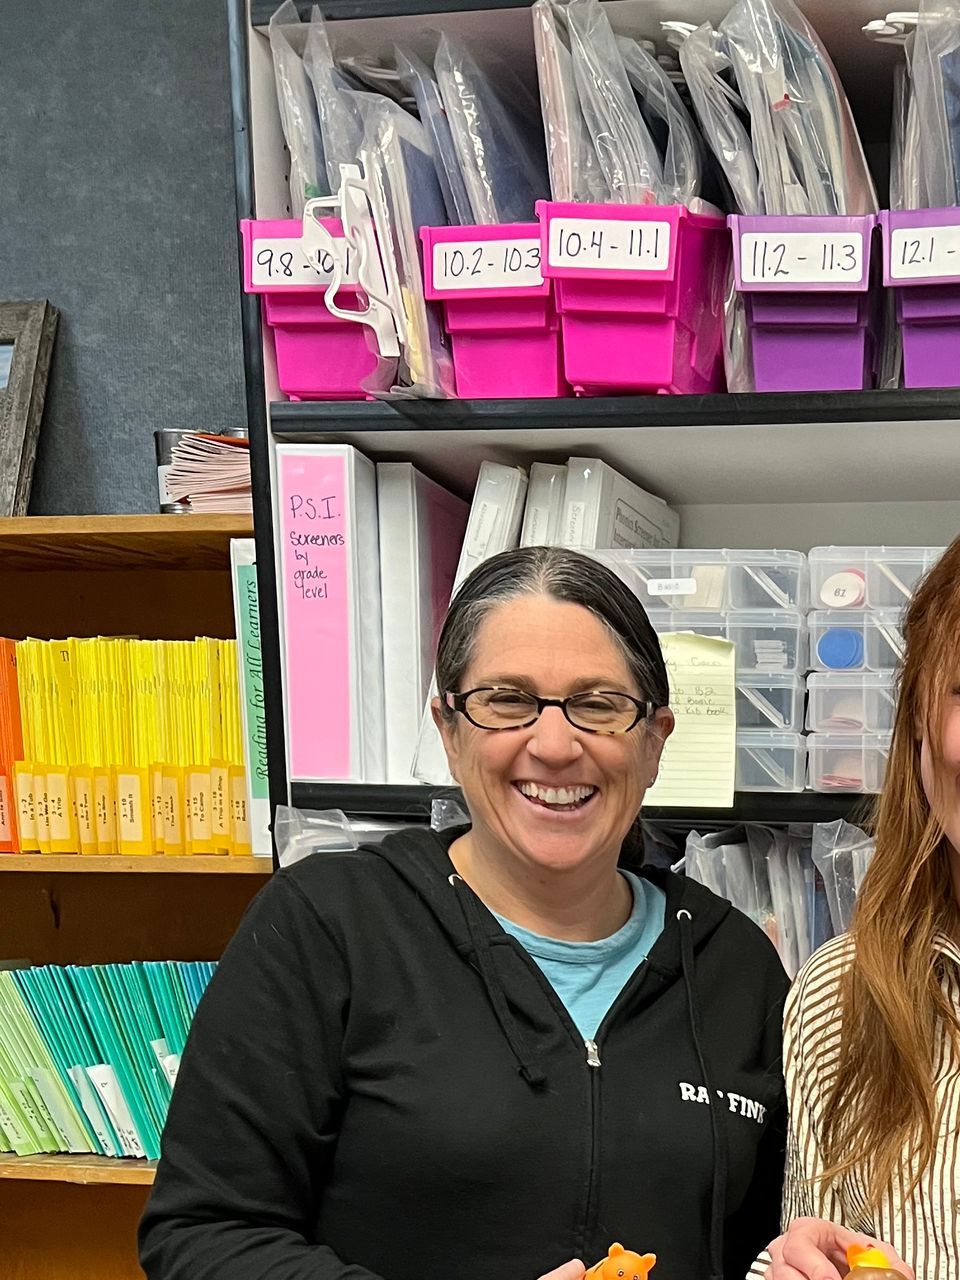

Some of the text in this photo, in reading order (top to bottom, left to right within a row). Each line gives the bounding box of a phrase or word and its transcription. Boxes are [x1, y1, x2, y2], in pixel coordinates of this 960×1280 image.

[558, 228, 603, 258] 10.4
[629, 228, 659, 258] 11.1
[901, 236, 936, 265] 12.1
[257, 249, 293, 277] 9.8
[444, 247, 483, 277] 10.2
[752, 240, 788, 278] 11.2
[821, 243, 858, 272] 11.3
[290, 494, 341, 520] P.S.I.
[289, 530, 345, 546] Screeners
[294, 549, 308, 566] by
[294, 565, 328, 588] grade
[302, 582, 328, 599] level
[246, 579, 262, 650] Learners
[246, 656, 264, 680] All
[249, 685, 266, 711] for
[679, 1082, 724, 1105] RA
